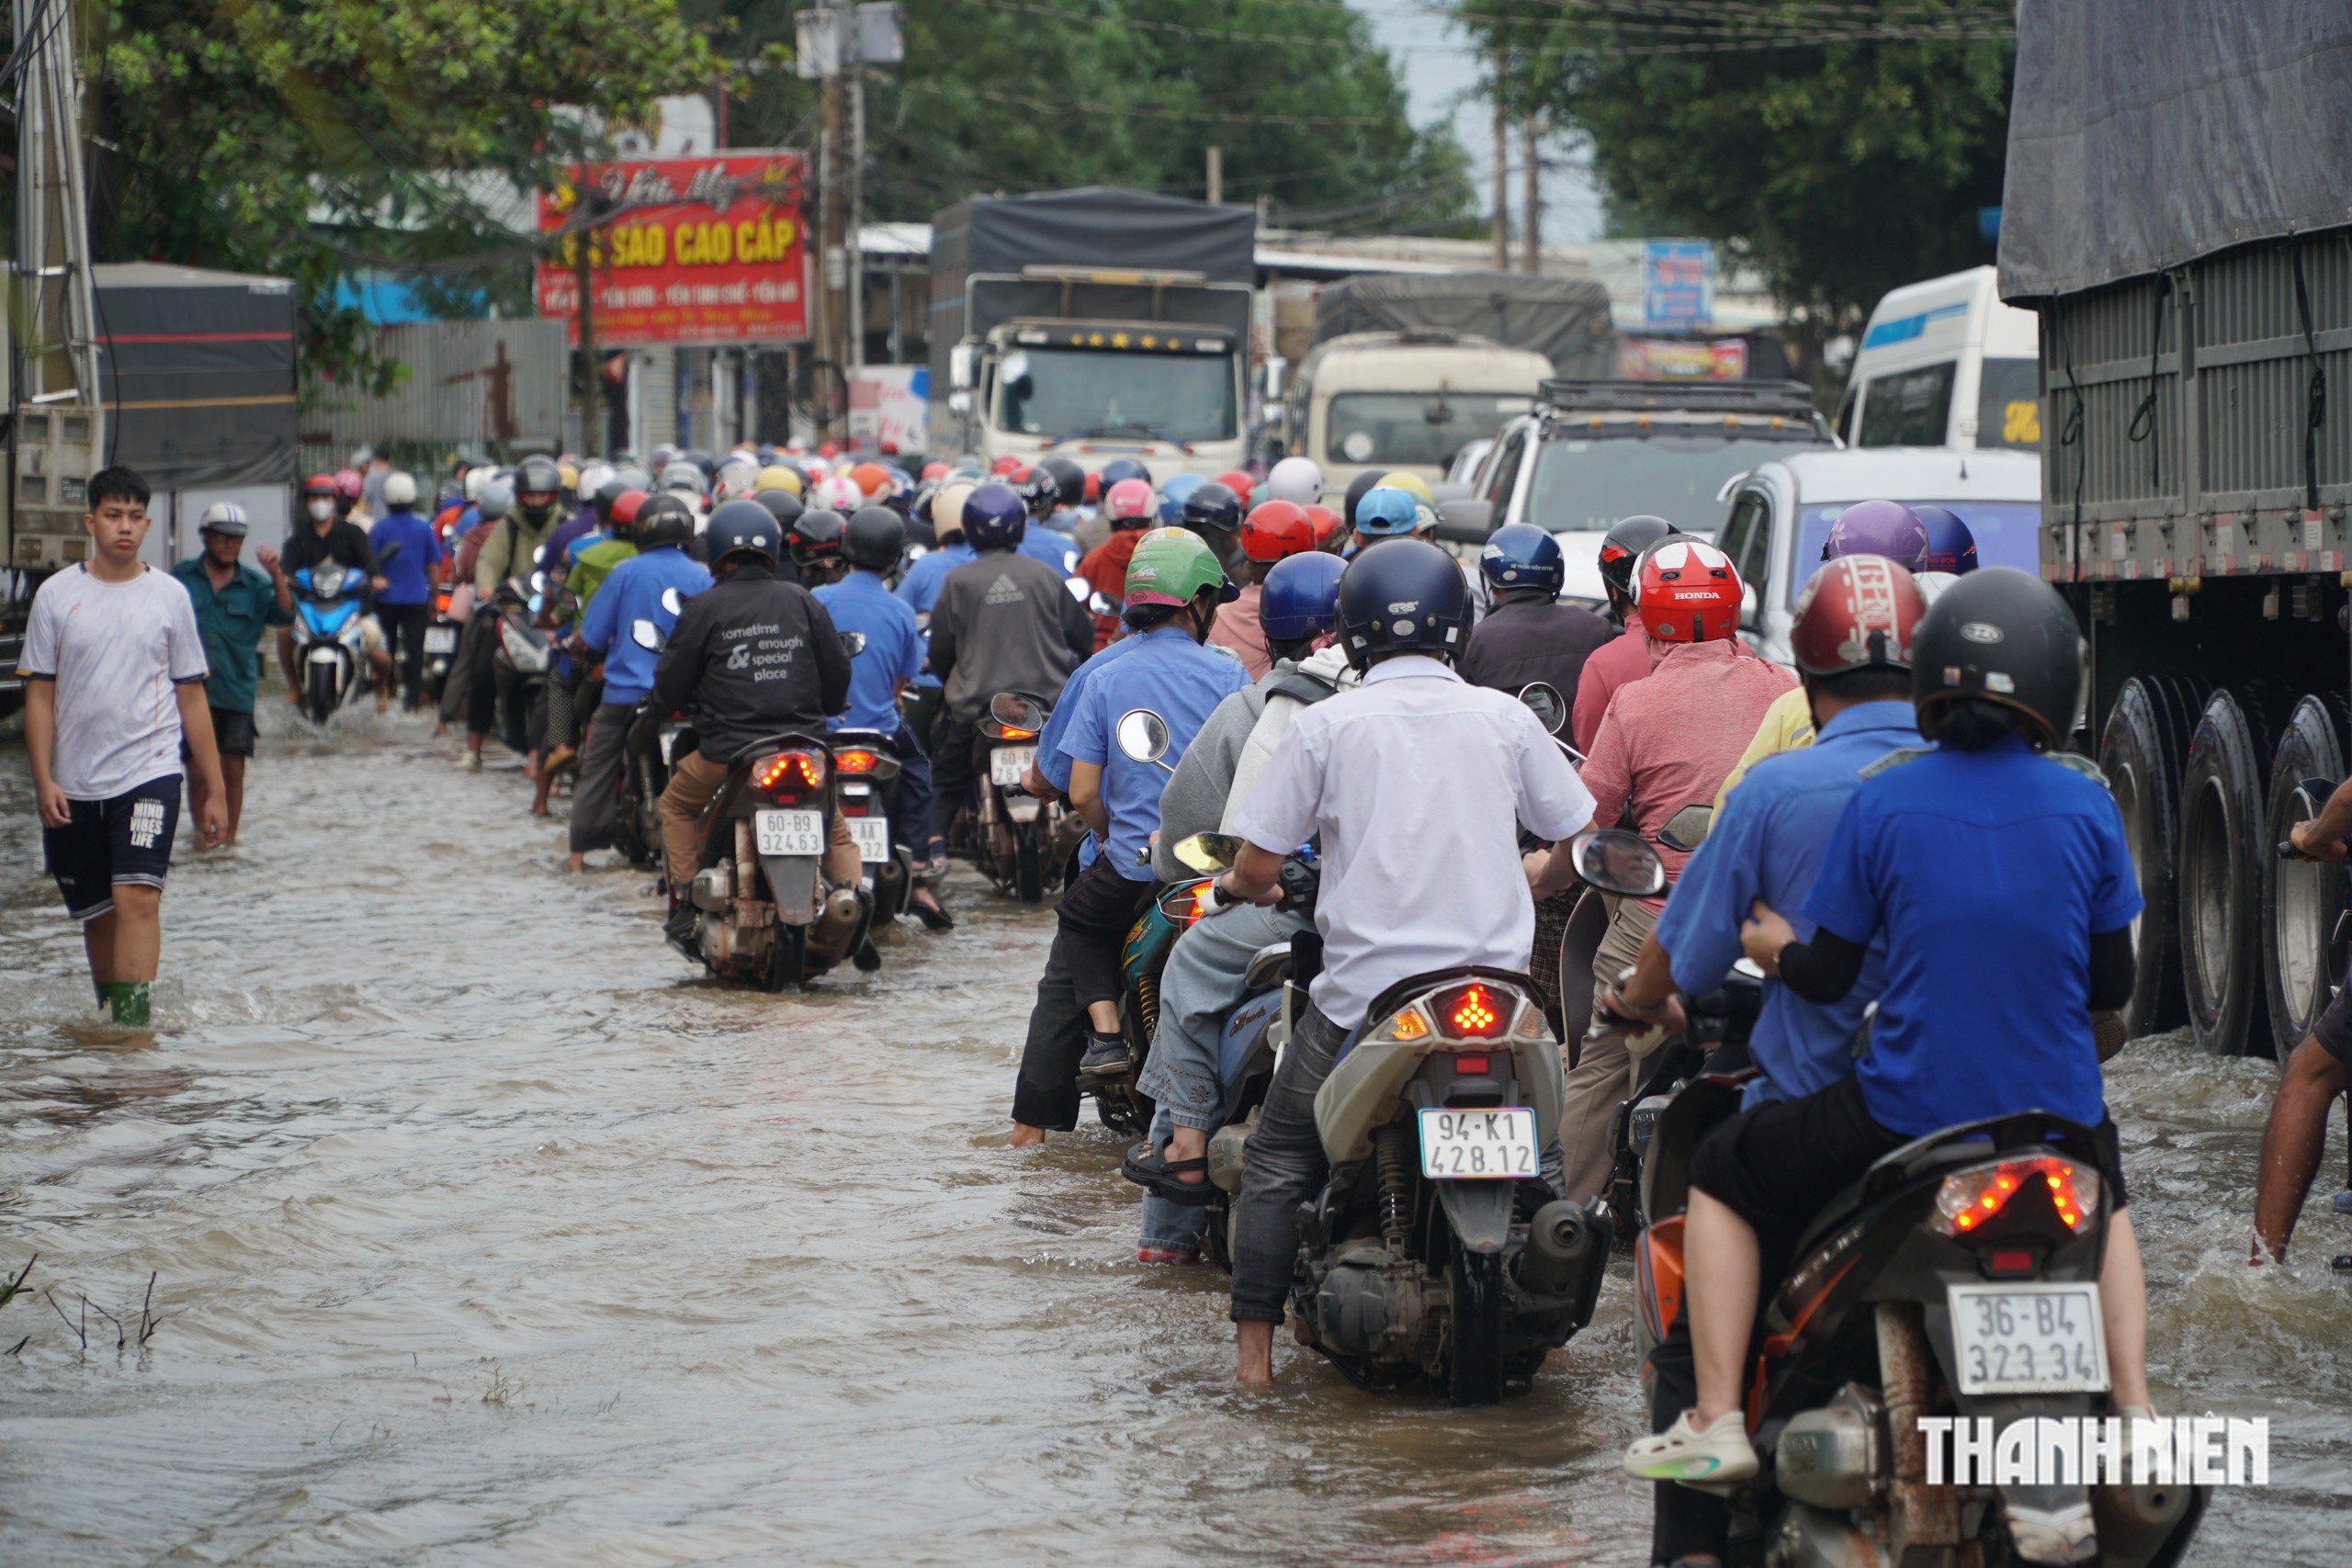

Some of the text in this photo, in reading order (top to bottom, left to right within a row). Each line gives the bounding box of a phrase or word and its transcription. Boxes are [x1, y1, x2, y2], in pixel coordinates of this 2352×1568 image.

[674, 220, 732, 265] CAO
[736, 204, 796, 265] CẤP
[721, 624, 779, 640] sometime
[758, 636, 803, 650] enough
[727, 644, 792, 670] & special
[754, 668, 787, 682] place
[133, 802, 164, 819] MIND
[130, 817, 163, 835] VIBES
[767, 816, 810, 832] 60-B9
[130, 832, 154, 849] LIFE
[763, 834, 819, 852] 324.63
[1439, 1113, 1515, 1141] 94-K1
[1430, 1145, 1532, 1174] 428.12
[1976, 1296, 2075, 1337] 36-B4
[1969, 1342, 2093, 1383] 323.34
